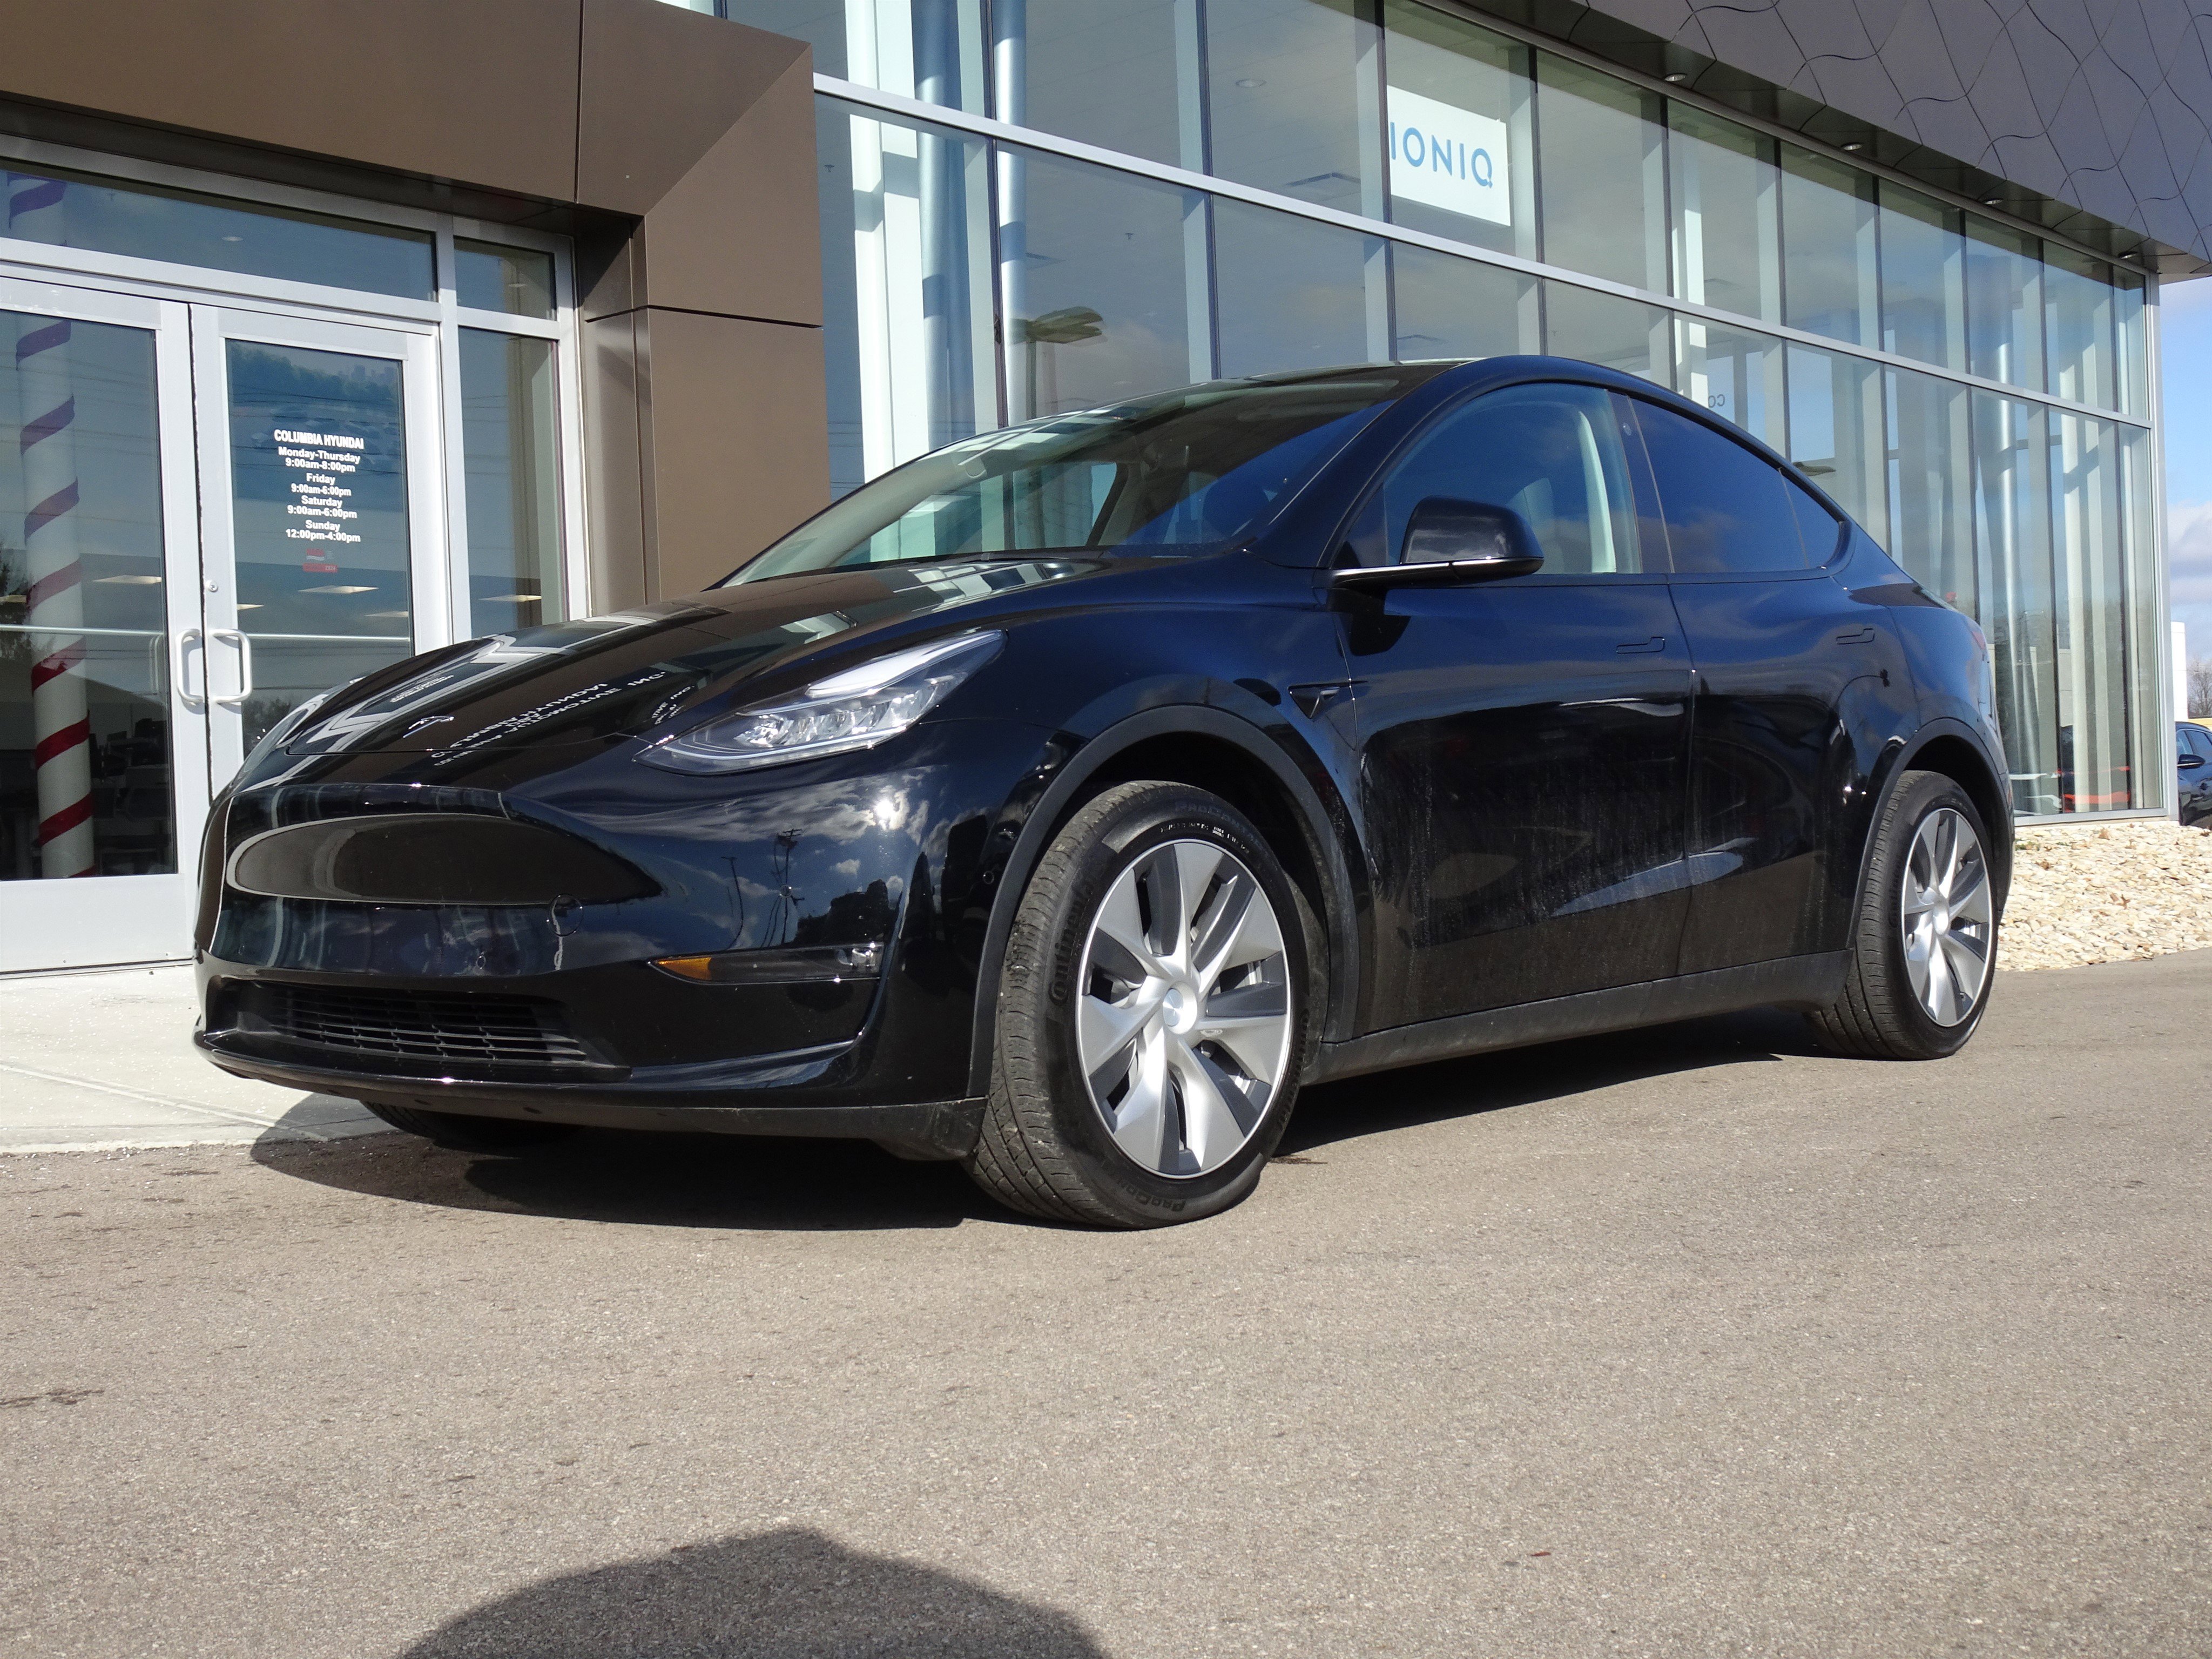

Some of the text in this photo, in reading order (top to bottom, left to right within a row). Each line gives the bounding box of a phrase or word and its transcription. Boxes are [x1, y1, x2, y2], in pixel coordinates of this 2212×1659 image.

[1390, 122, 1493, 188] IONIQ
[274, 429, 364, 449] COLUMBIA HYUNDAI
[278, 447, 361, 464] Monday-Thursday
[285, 457, 355, 473] 9:00am-8:00pm
[306, 473, 335, 485] Friday
[291, 483, 352, 497] 9:00am-6:00pm
[301, 495, 342, 509] Saturday
[287, 505, 357, 520] 9:00am-6:00pm
[306, 520, 340, 532] Sunday
[286, 529, 361, 543] 12:00pm-4:00pm
